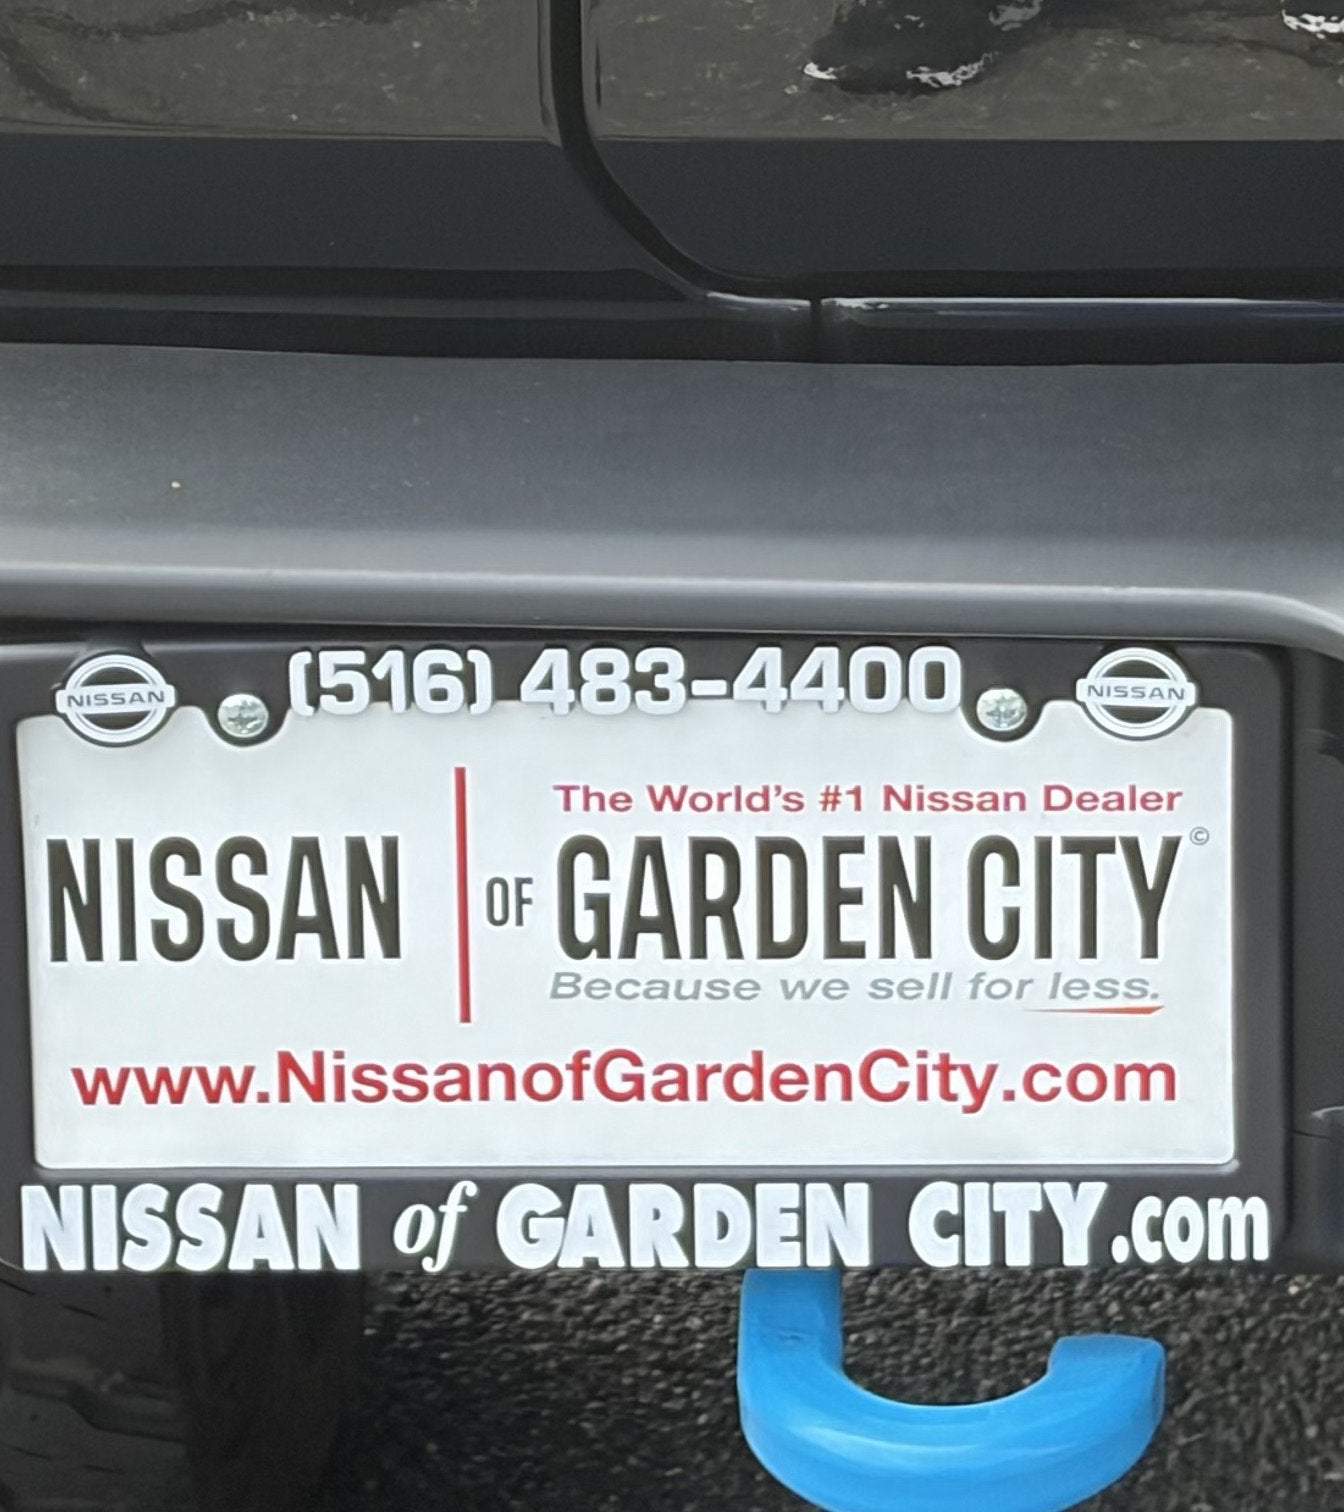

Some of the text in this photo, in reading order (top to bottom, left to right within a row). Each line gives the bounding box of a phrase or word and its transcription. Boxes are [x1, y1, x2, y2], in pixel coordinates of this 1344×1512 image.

[66, 688, 166, 709] NISSAN
[288, 645, 963, 716] (516) 483-4400
[1086, 683, 1186, 702] NISSAN
[552, 784, 634, 814] The
[818, 784, 864, 814] #1
[882, 783, 1028, 814] Nissan
[1042, 783, 1184, 814] Dealer
[45, 834, 402, 964] NISSAN
[485, 875, 534, 928] OF
[555, 833, 933, 963] GARDEN
[966, 833, 1183, 962] CITY
[549, 971, 1160, 1003] Because we sell for less.
[71, 1048, 1177, 1115] www.NissanofGardenCity.com
[20, 1182, 362, 1273] NISSAN
[392, 1179, 479, 1273] of
[494, 1181, 873, 1272] GARDEN
